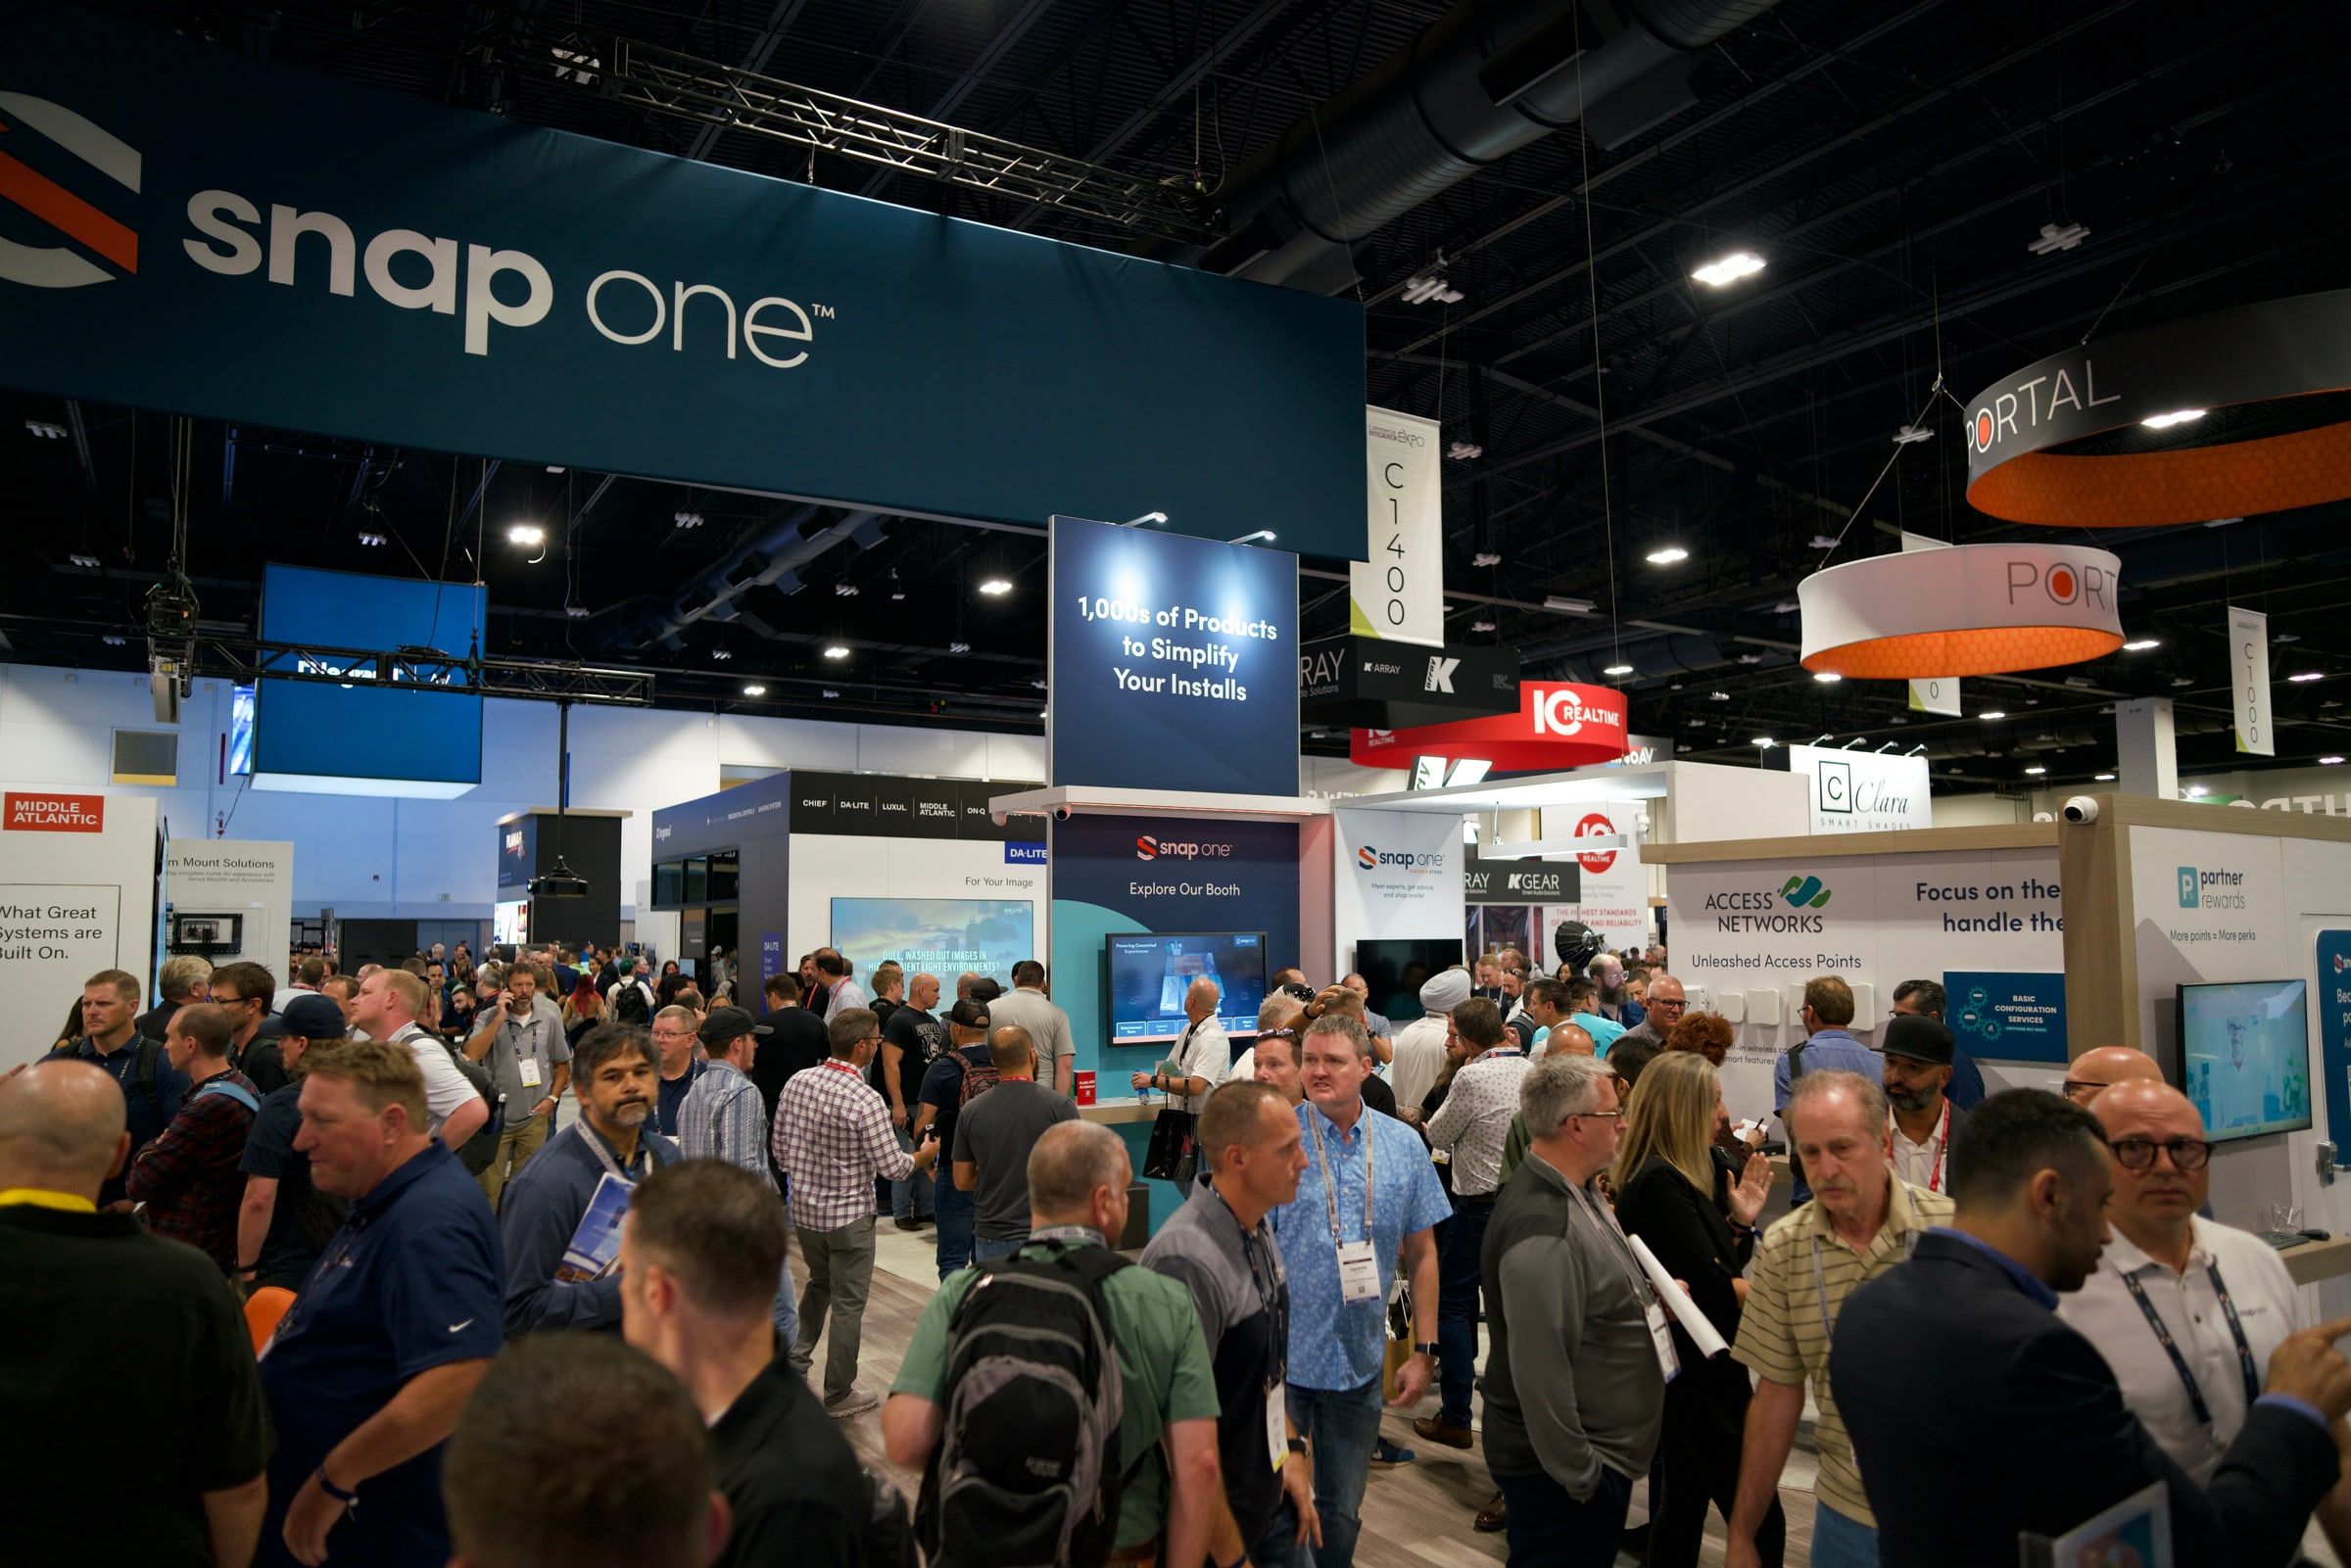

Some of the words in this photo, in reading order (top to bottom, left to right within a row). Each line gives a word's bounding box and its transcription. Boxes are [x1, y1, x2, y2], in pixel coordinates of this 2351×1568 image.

[183, 189, 554, 356] snap
[1966, 359, 2121, 466] PORTAL
[1079, 596, 1150, 624] 1,000s
[1156, 606, 1178, 627] of
[1184, 608, 1277, 640] Products
[1123, 637, 1145, 657] to
[1152, 638, 1239, 673] Simplify
[1114, 668, 1165, 692] Your
[1172, 674, 1247, 701] Installs
[1563, 706, 1620, 727] REALTIME
[1855, 779, 1909, 814] Clara
[15, 800, 80, 813] MIDDLE
[802, 799, 828, 808] CHIEF
[882, 803, 907, 812] LUXUL
[1820, 818, 1858, 828] SMART
[1160, 842, 1198, 861] snap
[183, 857, 219, 868] Mount
[222, 858, 275, 869] Solutions
[1379, 852, 1415, 870] snap
[965, 877, 981, 885] For
[984, 877, 1004, 886] Your
[1006, 878, 1033, 888] Image
[2200, 868, 2243, 890] partner
[1129, 881, 1176, 898] Explore
[1179, 882, 1204, 895] Our
[1206, 883, 1240, 896] Booth
[1916, 882, 1979, 901] Focus
[1986, 885, 2014, 900] on
[2021, 879, 2061, 899] the
[1704, 892, 1773, 910] ACCESS
[2201, 888, 2246, 909] rewards
[0, 906, 41, 919] What
[47, 905, 97, 920] Great
[1718, 915, 1823, 933] NETWORKS
[1943, 912, 2023, 932] handle
[2030, 911, 2064, 931] the
[73, 928, 102, 939] are
[2170, 929, 2188, 941] More
[2190, 928, 2212, 944] points
[2219, 929, 2237, 941] More
[2238, 928, 2256, 944] perks
[38, 945, 69, 959] On.
[883, 951, 903, 962] DULL,
[905, 951, 935, 961] WASHED
[936, 951, 950, 961] OUT
[951, 951, 978, 961] IMAGES
[980, 951, 986, 961] IN
[922, 962, 941, 972] LIGHT
[942, 962, 1000, 972] ENVIRONMENTS?
[1692, 953, 1760, 969] Unleashed
[1764, 954, 1812, 969] Access
[1817, 953, 1861, 969] Points
[1994, 1005, 2057, 1014] CONFIGURATION
[1748, 1044, 1777, 1053] wireless
[1745, 1056, 1775, 1065] features
